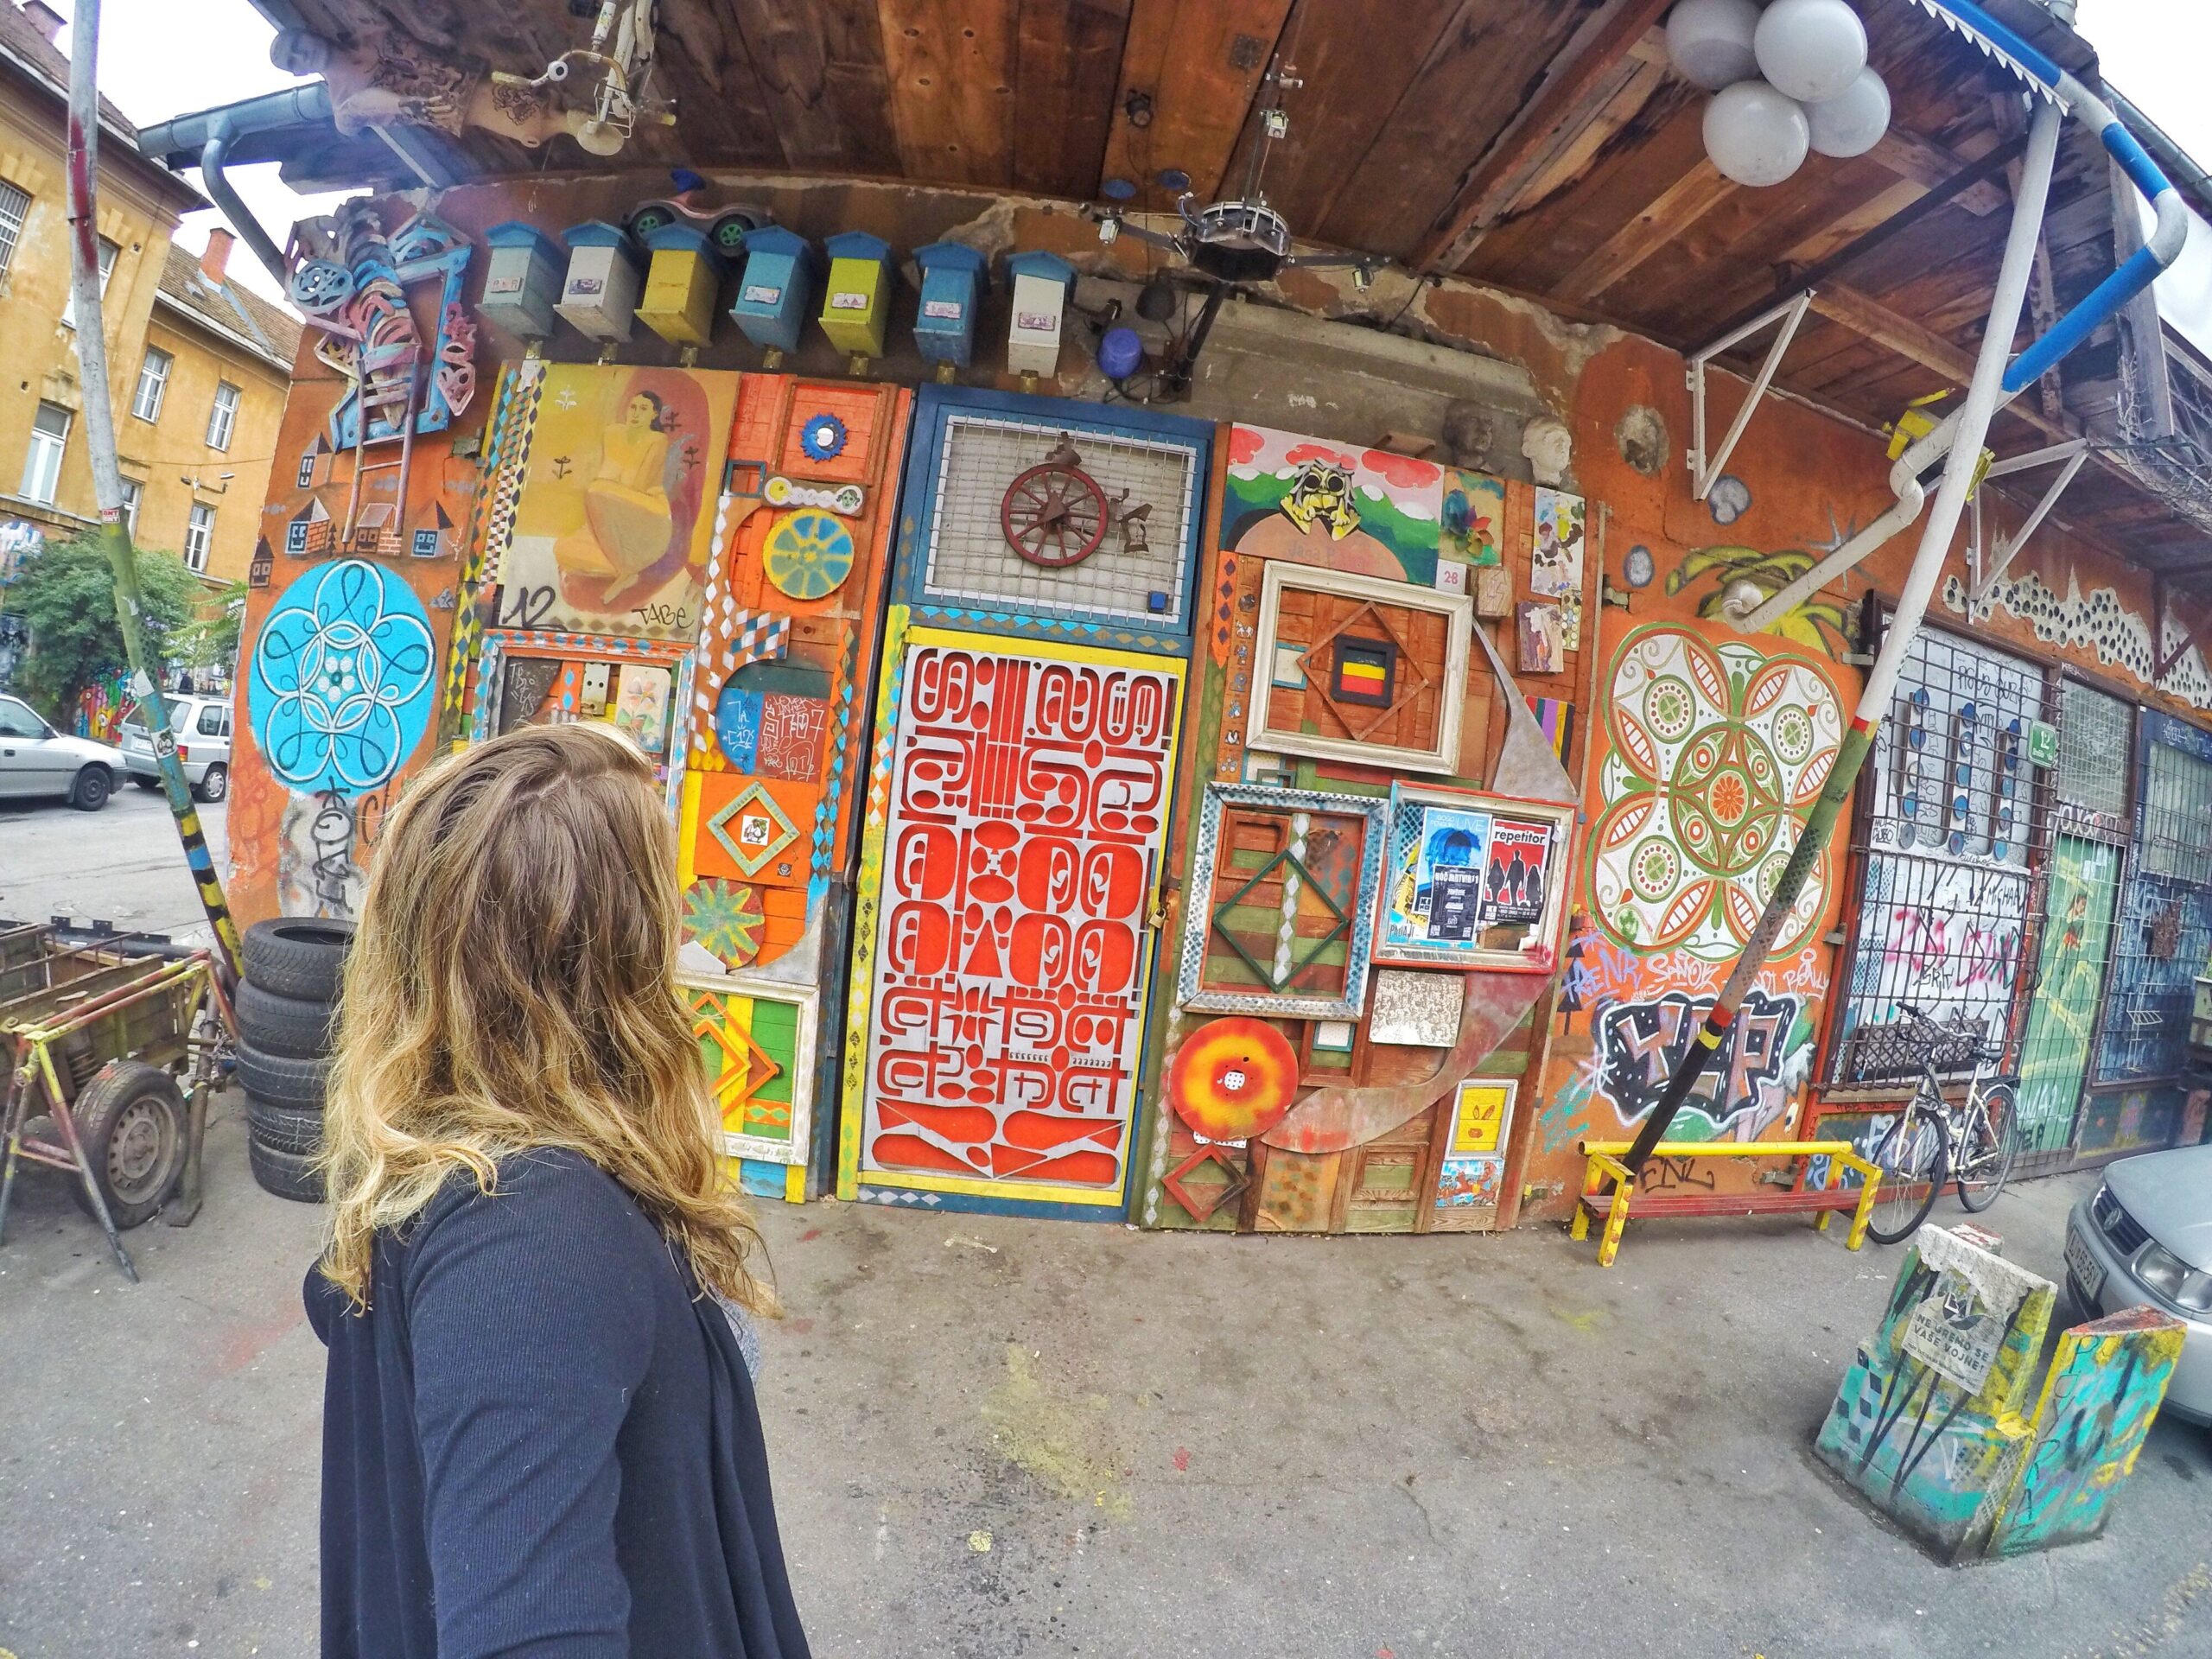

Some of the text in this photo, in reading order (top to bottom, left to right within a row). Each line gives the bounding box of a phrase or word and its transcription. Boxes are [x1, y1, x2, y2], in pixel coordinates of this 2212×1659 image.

[1444, 570, 1459, 585] 28
[2040, 730, 2050, 750] 12
[1457, 816, 1485, 832] LIVE
[1494, 830, 1546, 844] repetitor
[1916, 1314, 1989, 1363] NE GREMO SE
[1914, 1325, 1942, 1347] VAŠE
[1944, 1343, 1985, 1373] VOJNE!
